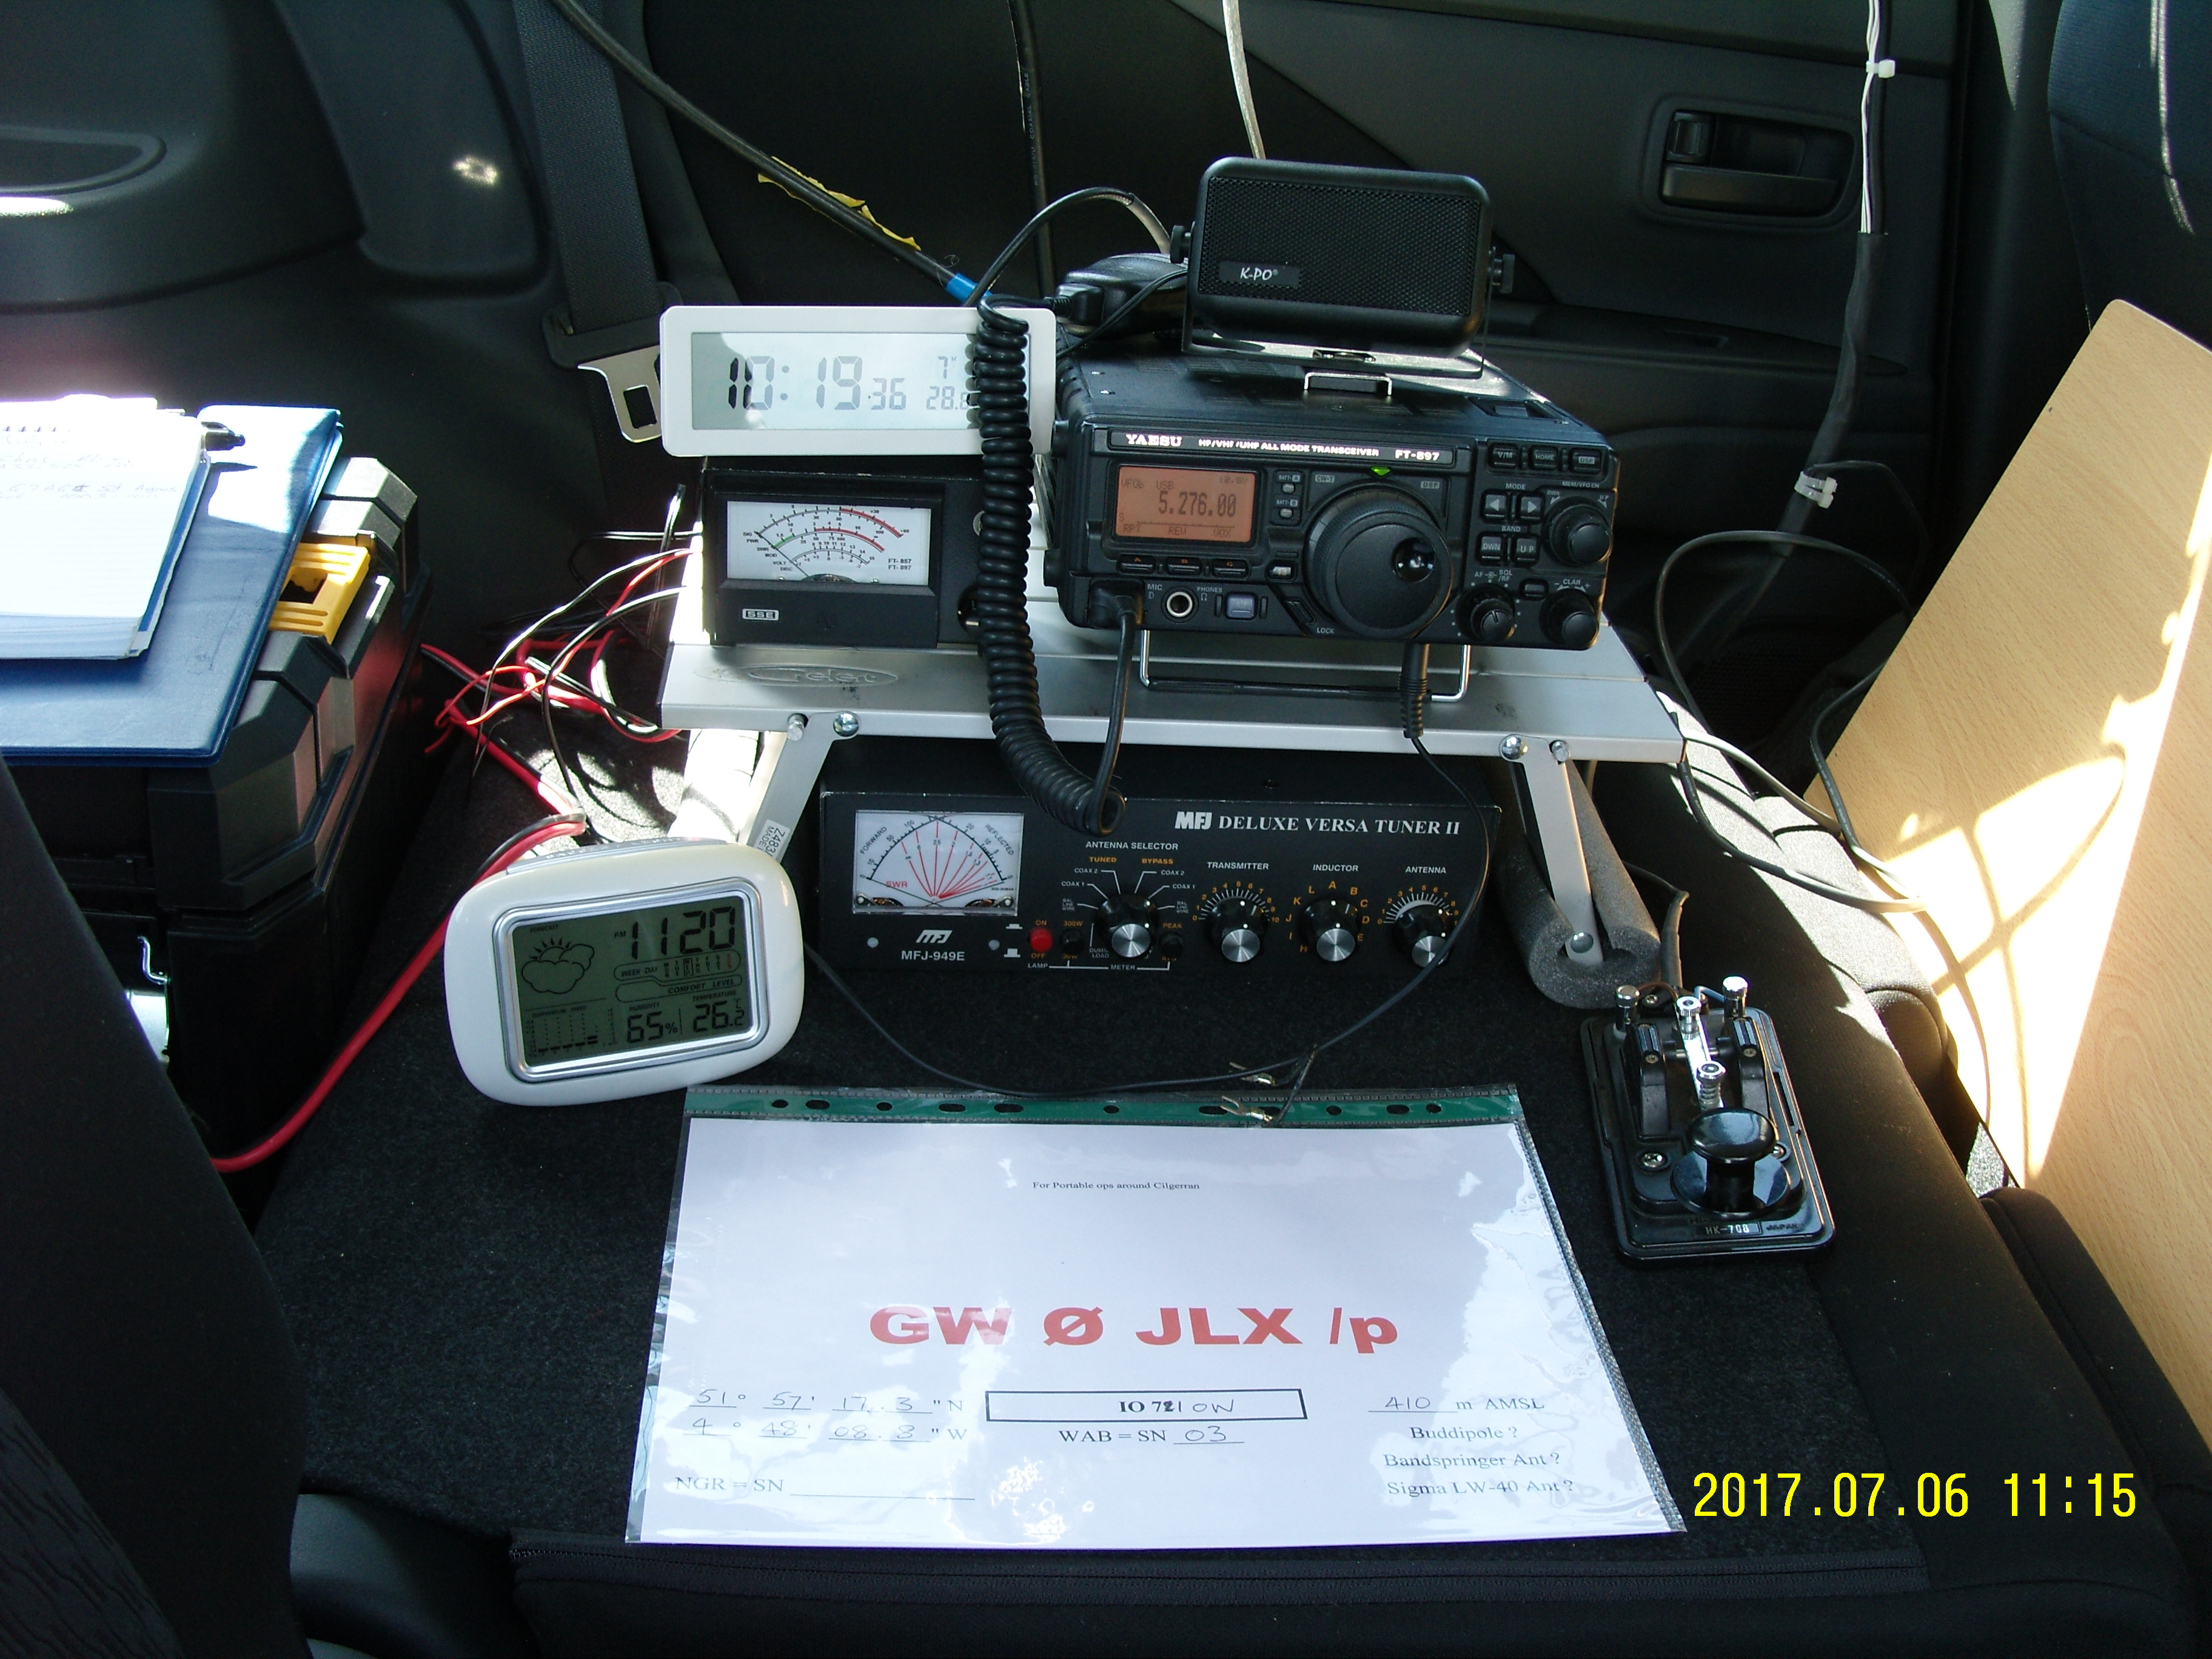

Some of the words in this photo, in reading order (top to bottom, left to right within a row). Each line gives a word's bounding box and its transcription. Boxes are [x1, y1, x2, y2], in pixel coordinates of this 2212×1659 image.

[937, 356, 949, 379] 7
[728, 356, 862, 410] 10:19
[871, 378, 907, 410] 36
[1126, 434, 1182, 447] YAESU
[1280, 444, 1309, 452] MODE
[1312, 445, 1379, 457] TRANSCEIVER
[1395, 449, 1440, 461] FT-897
[1156, 480, 1175, 490] USB
[1158, 490, 1236, 517] 5.276.00
[1124, 525, 1141, 534] RPT
[1168, 526, 1187, 536] REV
[747, 611, 774, 619] SSE
[1175, 811, 1213, 830] MFJ
[1218, 816, 1299, 831] DELUXE
[1304, 819, 1369, 833] VERSA
[1375, 820, 1441, 835] TUNER
[1446, 822, 1460, 835] II
[860, 826, 888, 855] FORWARD
[985, 824, 1014, 856] REFLECTED
[1207, 862, 1269, 870] TRANSMITTER
[1328, 880, 1336, 889] A
[1360, 899, 1369, 908] C
[1362, 916, 1370, 924] D
[530, 924, 559, 933] FORECAST
[901, 950, 965, 961] MFJ-949E
[622, 968, 641, 977] WEEK
[669, 983, 706, 994] COMFORT
[692, 990, 737, 1002] TEMPERATURE
[629, 1002, 660, 1011] HUMIDITY
[693, 1001, 745, 1033] 26.2
[1153, 1182, 1200, 1190] Cilgerran
[870, 1306, 1013, 1346] GW
[1135, 1307, 1303, 1346] JLX
[1329, 1307, 1398, 1354] /p
[1385, 1396, 1432, 1410] 410
[1456, 1401, 1473, 1410] m
[1485, 1398, 1545, 1410] AMSL
[1058, 1430, 1113, 1443] WAB
[1138, 1429, 1167, 1443] SN
[1184, 1426, 1227, 1442] 03
[1409, 1426, 1504, 1443] Buddipole
[1382, 1453, 1507, 1469] Bandspringer
[1513, 1453, 1547, 1466] Ant
[675, 1477, 725, 1491] NGR
[754, 1478, 785, 1492] SN
[1387, 1481, 1448, 1498] Sigma
[1527, 1480, 1560, 1492] Ant
